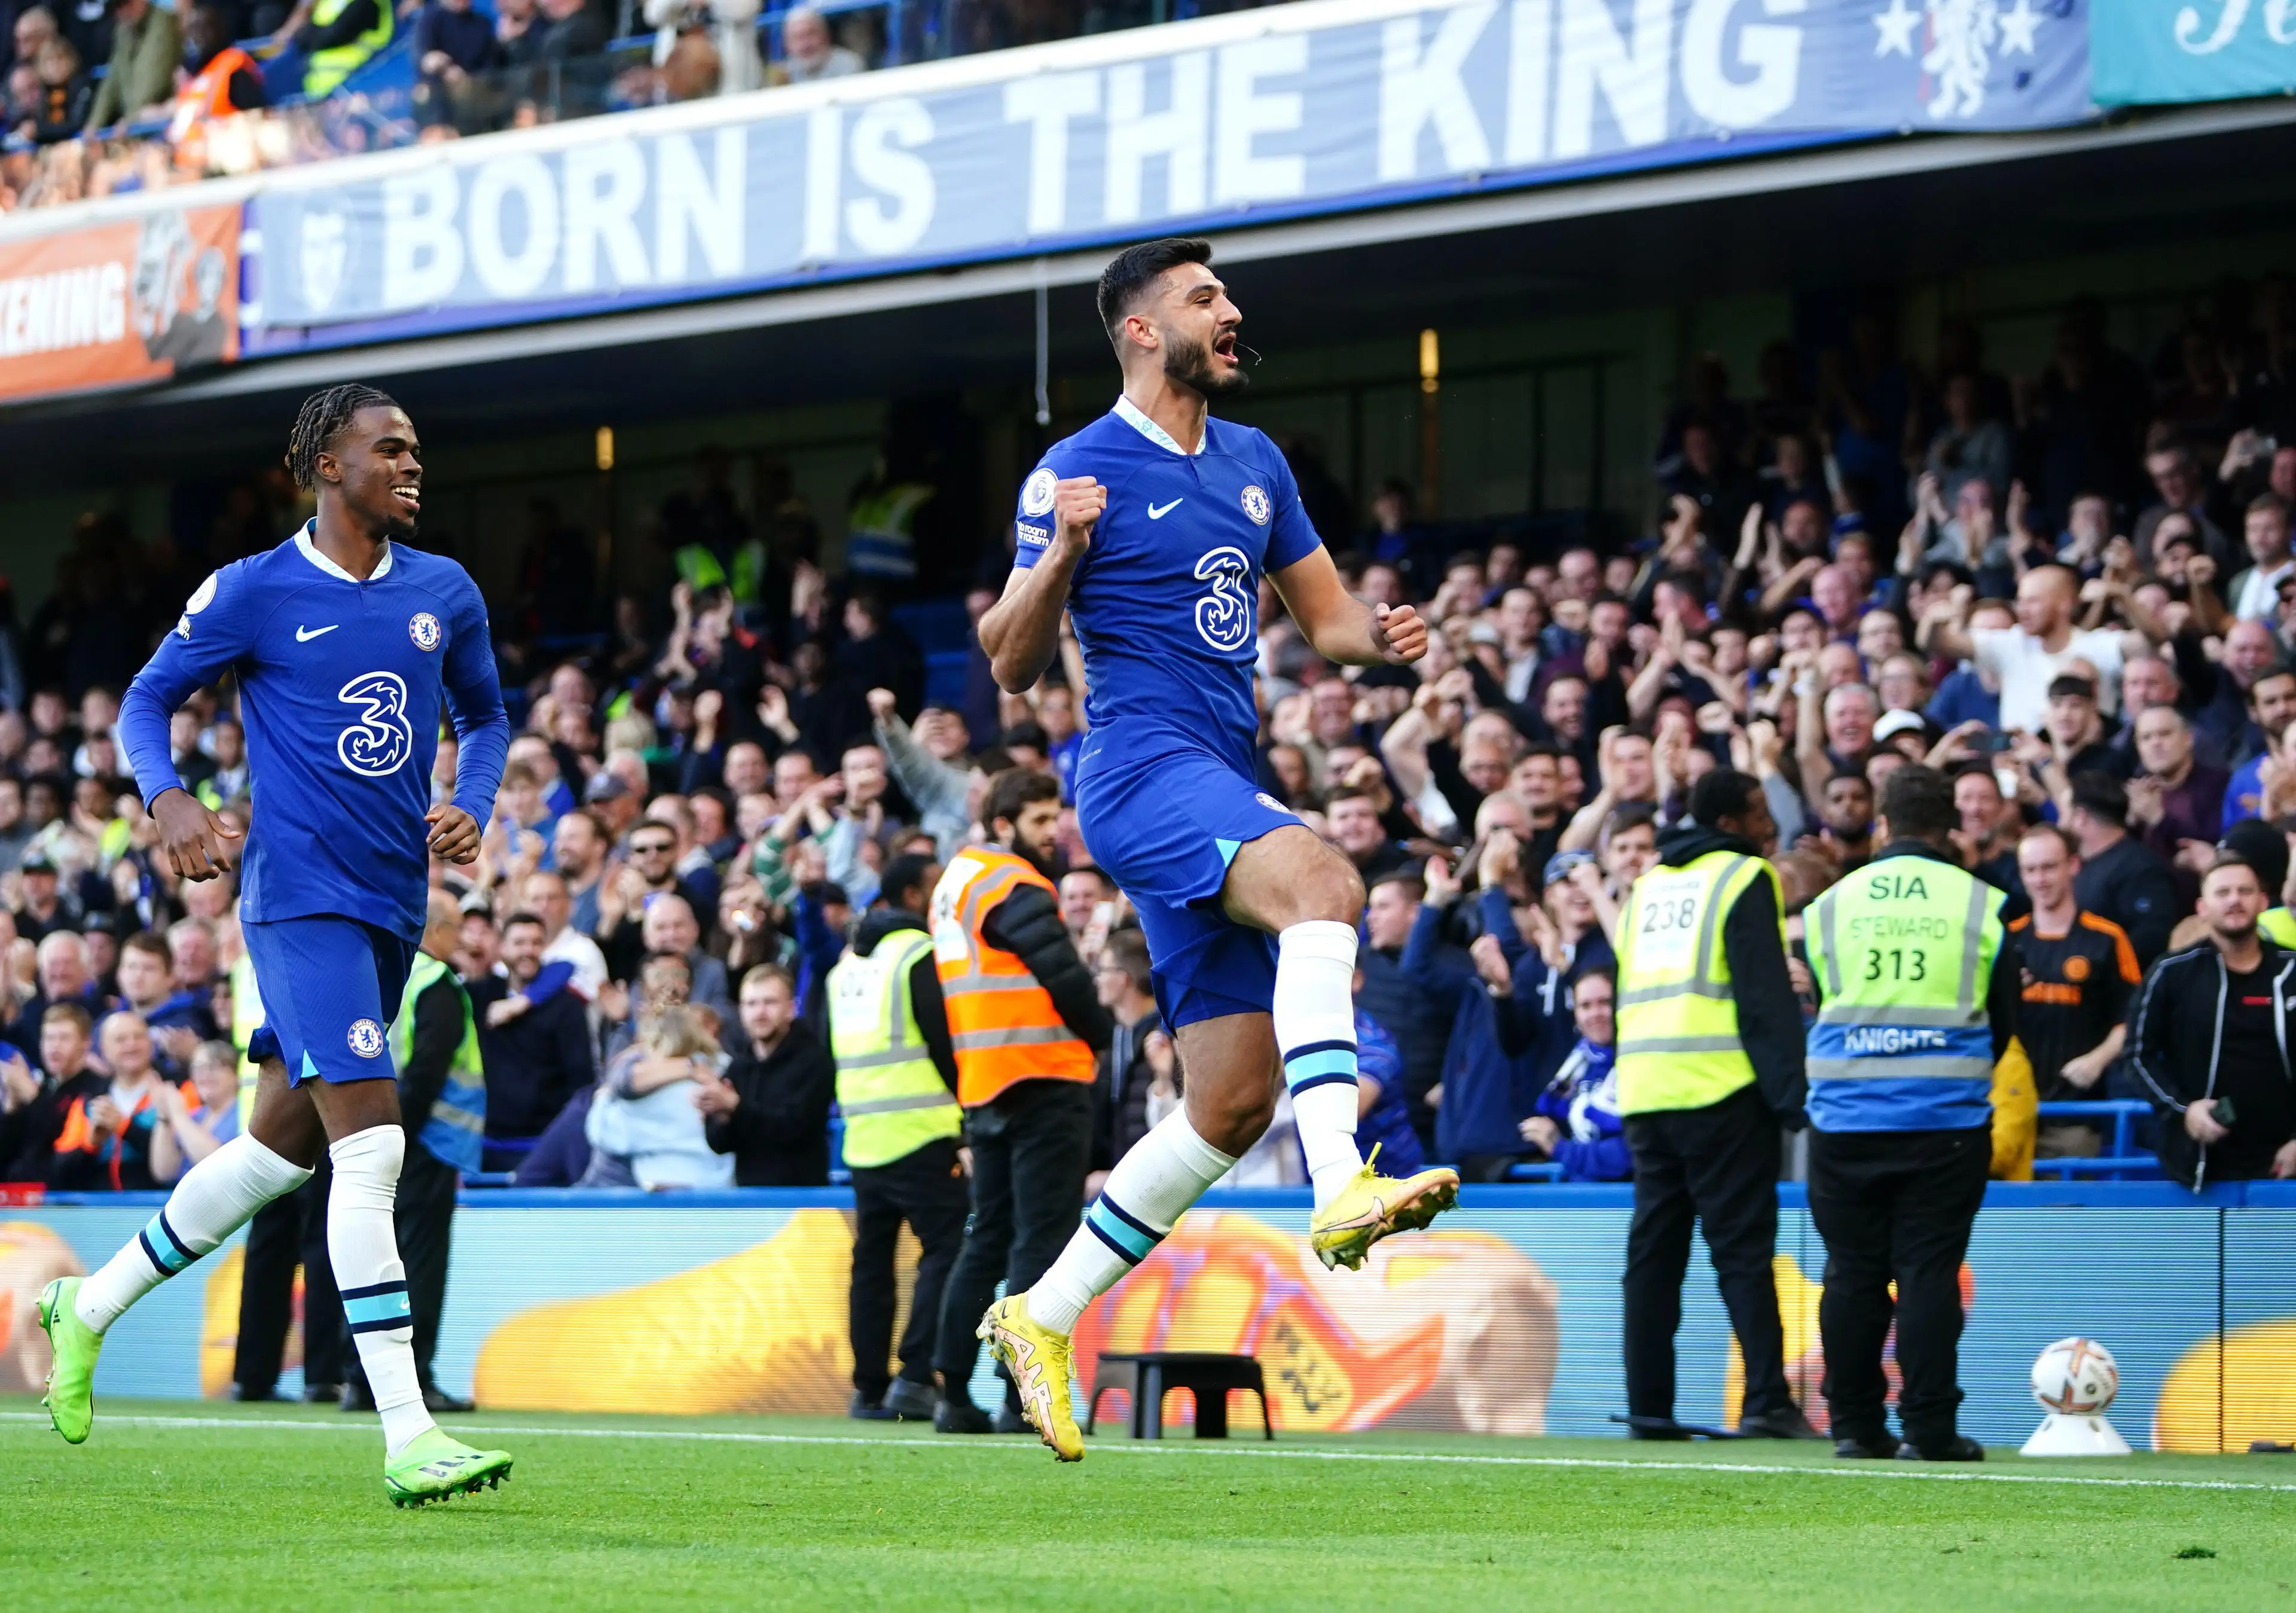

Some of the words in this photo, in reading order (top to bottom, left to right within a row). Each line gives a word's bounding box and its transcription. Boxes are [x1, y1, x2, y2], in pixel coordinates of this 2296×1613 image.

[381, 127, 747, 307] BORN
[800, 99, 936, 259] IS
[1003, 33, 1309, 235] THE
[1376, 0, 1804, 182] KING
[1869, 875, 1929, 900] SIA
[1642, 898, 1696, 933] 238
[1851, 916, 1949, 940] STEWARD
[1864, 947, 1926, 981] 313
[352, 1020, 375, 1030] CHELSEA
